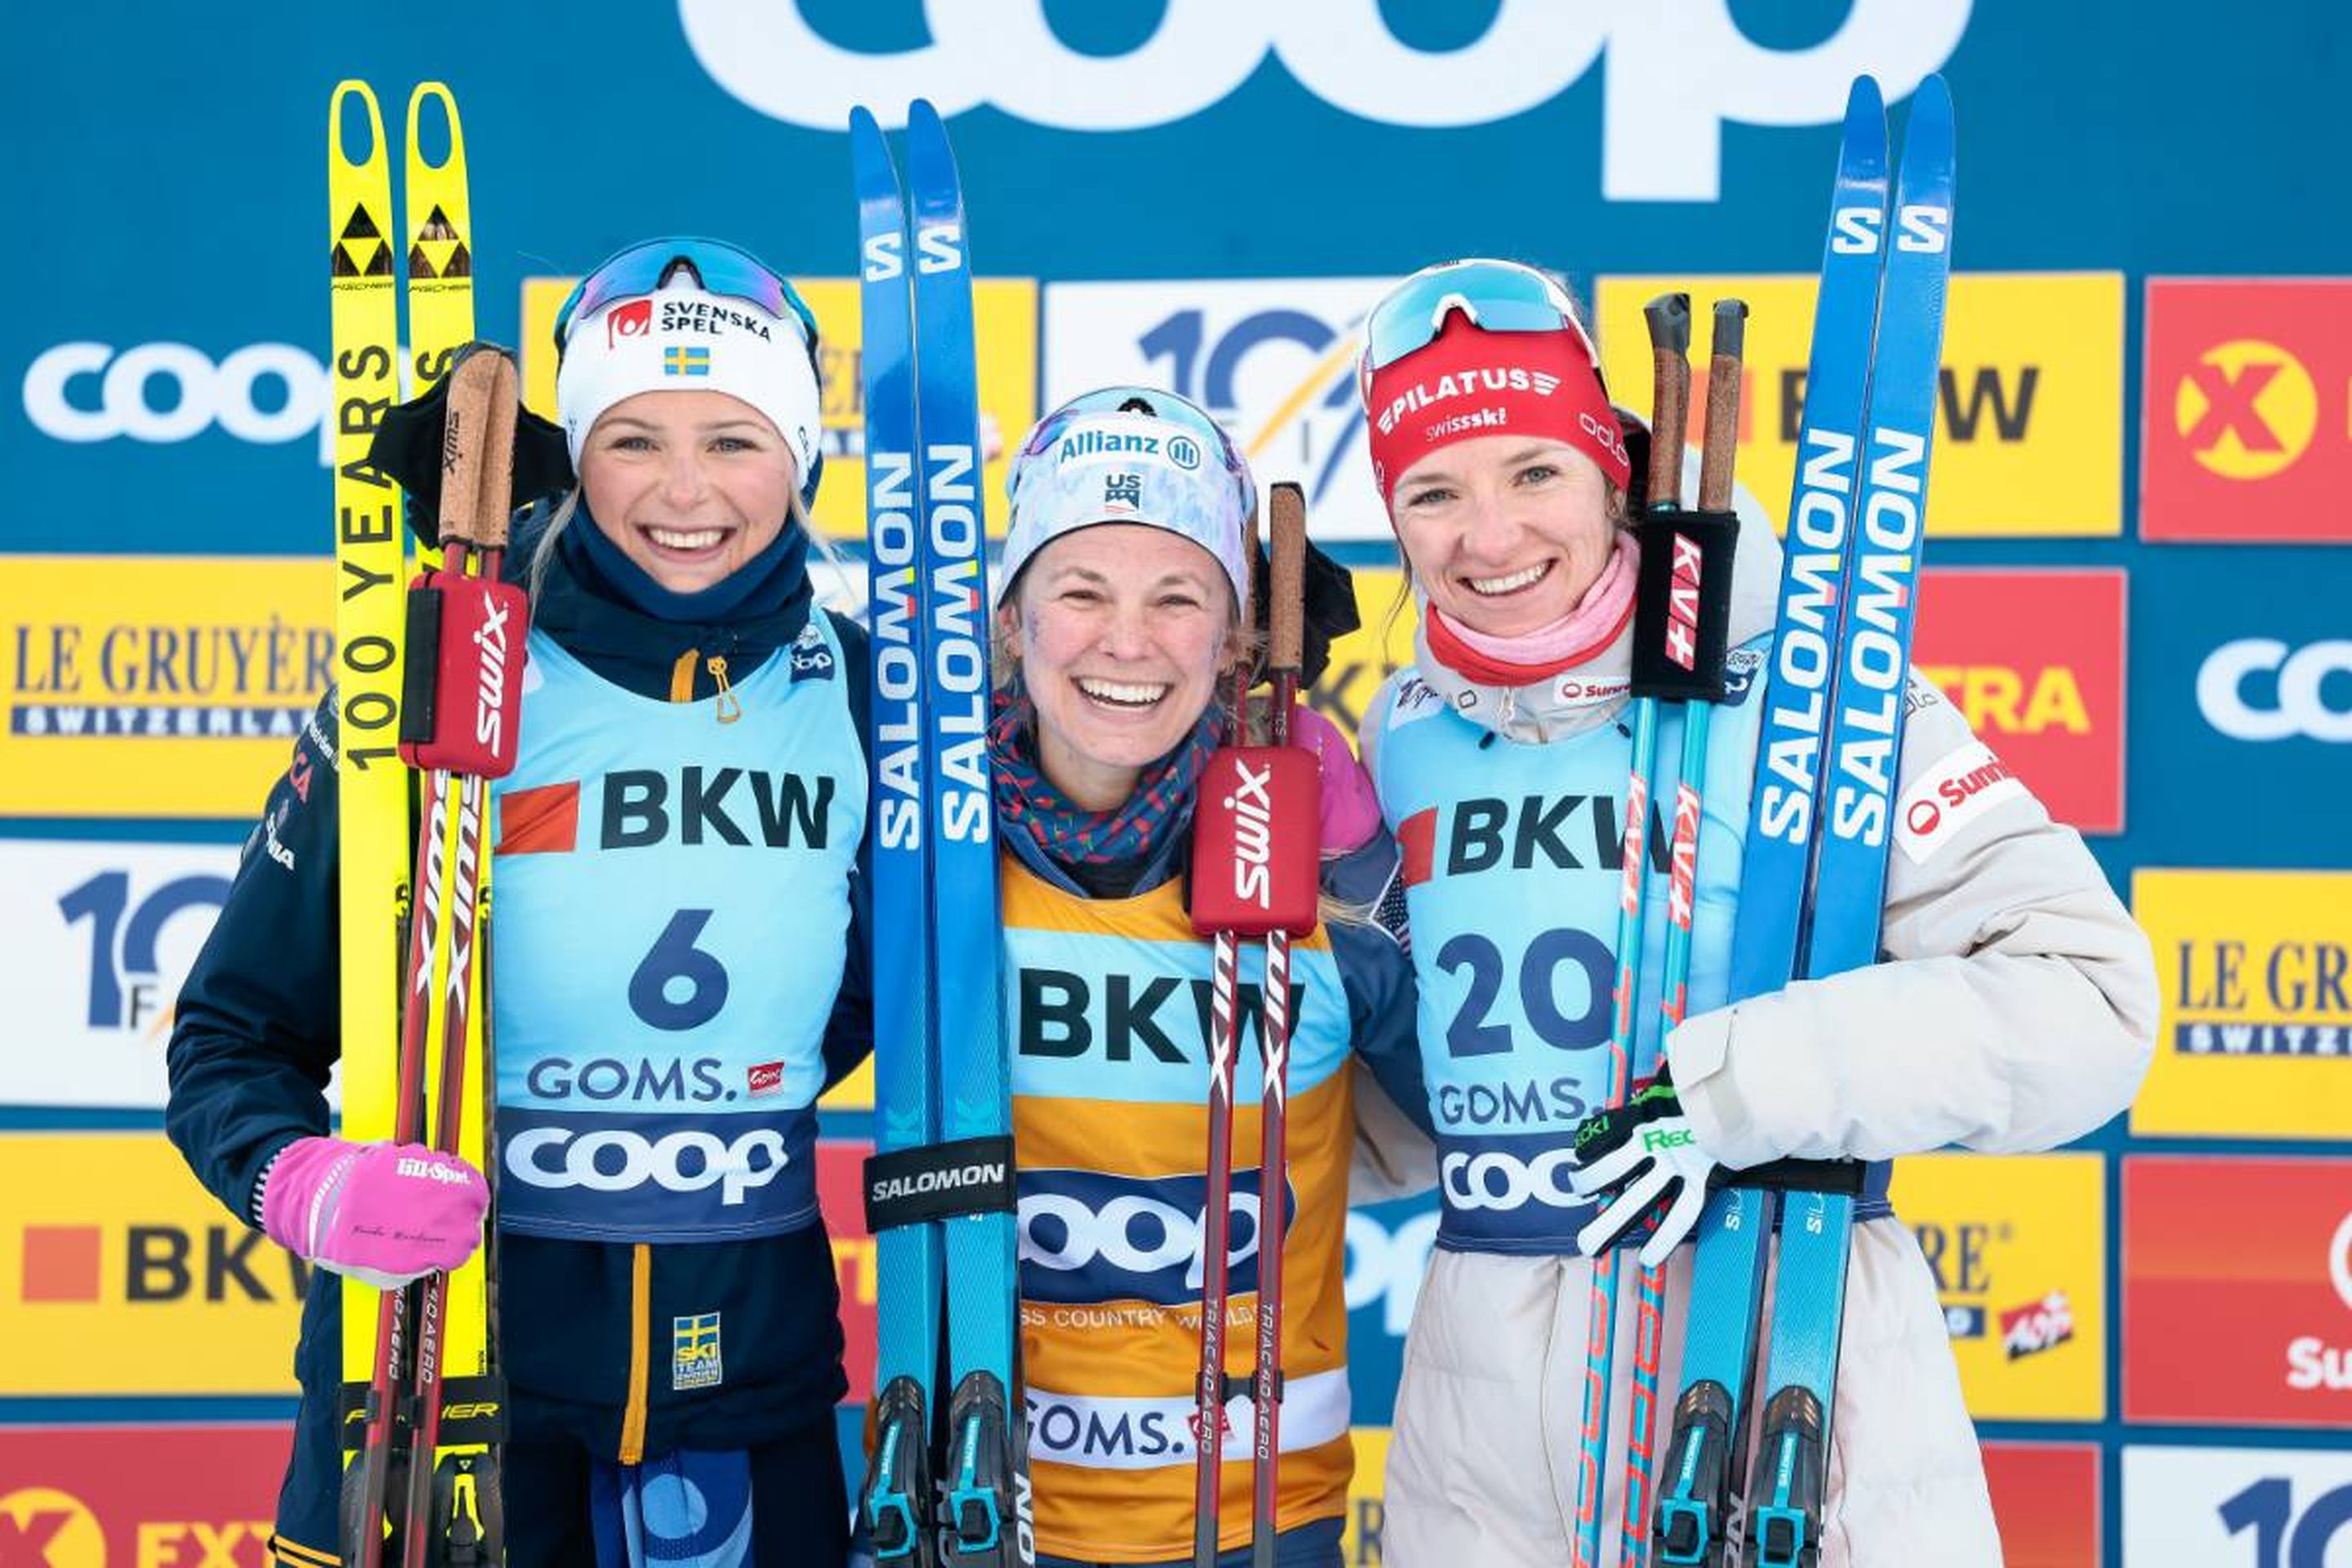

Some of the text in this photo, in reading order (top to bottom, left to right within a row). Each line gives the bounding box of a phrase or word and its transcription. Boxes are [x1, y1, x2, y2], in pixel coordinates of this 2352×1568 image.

[662, 316, 723, 335] SPEL
[663, 301, 771, 343] SVENSKA
[1391, 367, 1530, 424] PILATUS
[1061, 430, 1159, 463] Allianz
[338, 345, 399, 771] 100 YEARS
[1665, 532, 1702, 670] KV+
[14, 613, 336, 693] LE GRUYÈR
[871, 452, 920, 851] SALOMON
[927, 443, 989, 844] SALOMON
[1758, 427, 1855, 845] SALOMON
[1832, 425, 1926, 848] SALOMON
[24, 706, 317, 733] SWITZERLA
[599, 765, 835, 850] BKW
[627, 909, 729, 1031] 6
[1435, 927, 1617, 1059] 20
[2177, 940, 2247, 1010] LE
[1018, 967, 1306, 1067] BKW
[527, 1056, 738, 1102] GOMS.
[1439, 1076, 1606, 1125] GOMS.
[505, 1126, 790, 1206] coop
[871, 1162, 1005, 1202] SALOMON
[1441, 1147, 1601, 1210] coo
[1018, 1192, 1260, 1290] oop
[389, 1316, 401, 1380] AERO
[1054, 1307, 1165, 1328] COUNTRY
[1204, 1296, 1219, 1361] TRIAC
[1261, 1302, 1275, 1365] TRIAC
[421, 1321, 436, 1383] AERO
[1200, 1394, 1213, 1454] AERO
[1256, 1400, 1270, 1460] AERO
